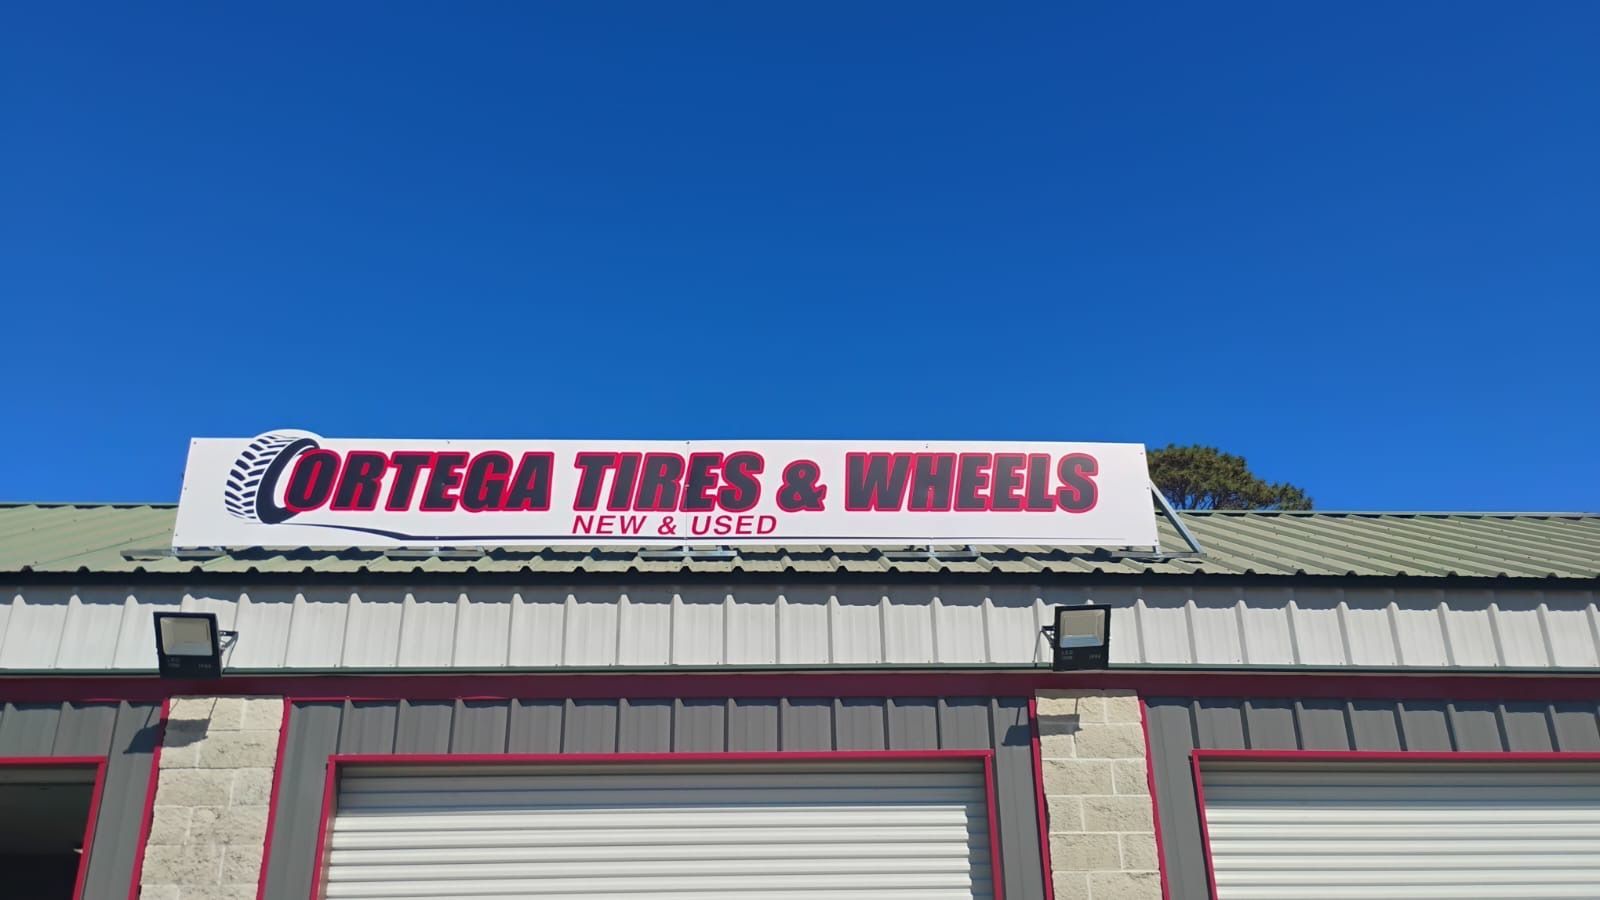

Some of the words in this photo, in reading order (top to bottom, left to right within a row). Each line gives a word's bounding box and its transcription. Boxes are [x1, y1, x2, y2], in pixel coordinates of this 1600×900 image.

[282, 449, 555, 513] ORTEGA
[573, 450, 765, 514] TIRES
[775, 458, 828, 513] &
[844, 451, 1099, 514] WHEELS
[572, 515, 647, 535] NEW
[657, 516, 676, 535] &
[691, 515, 777, 536] USED
